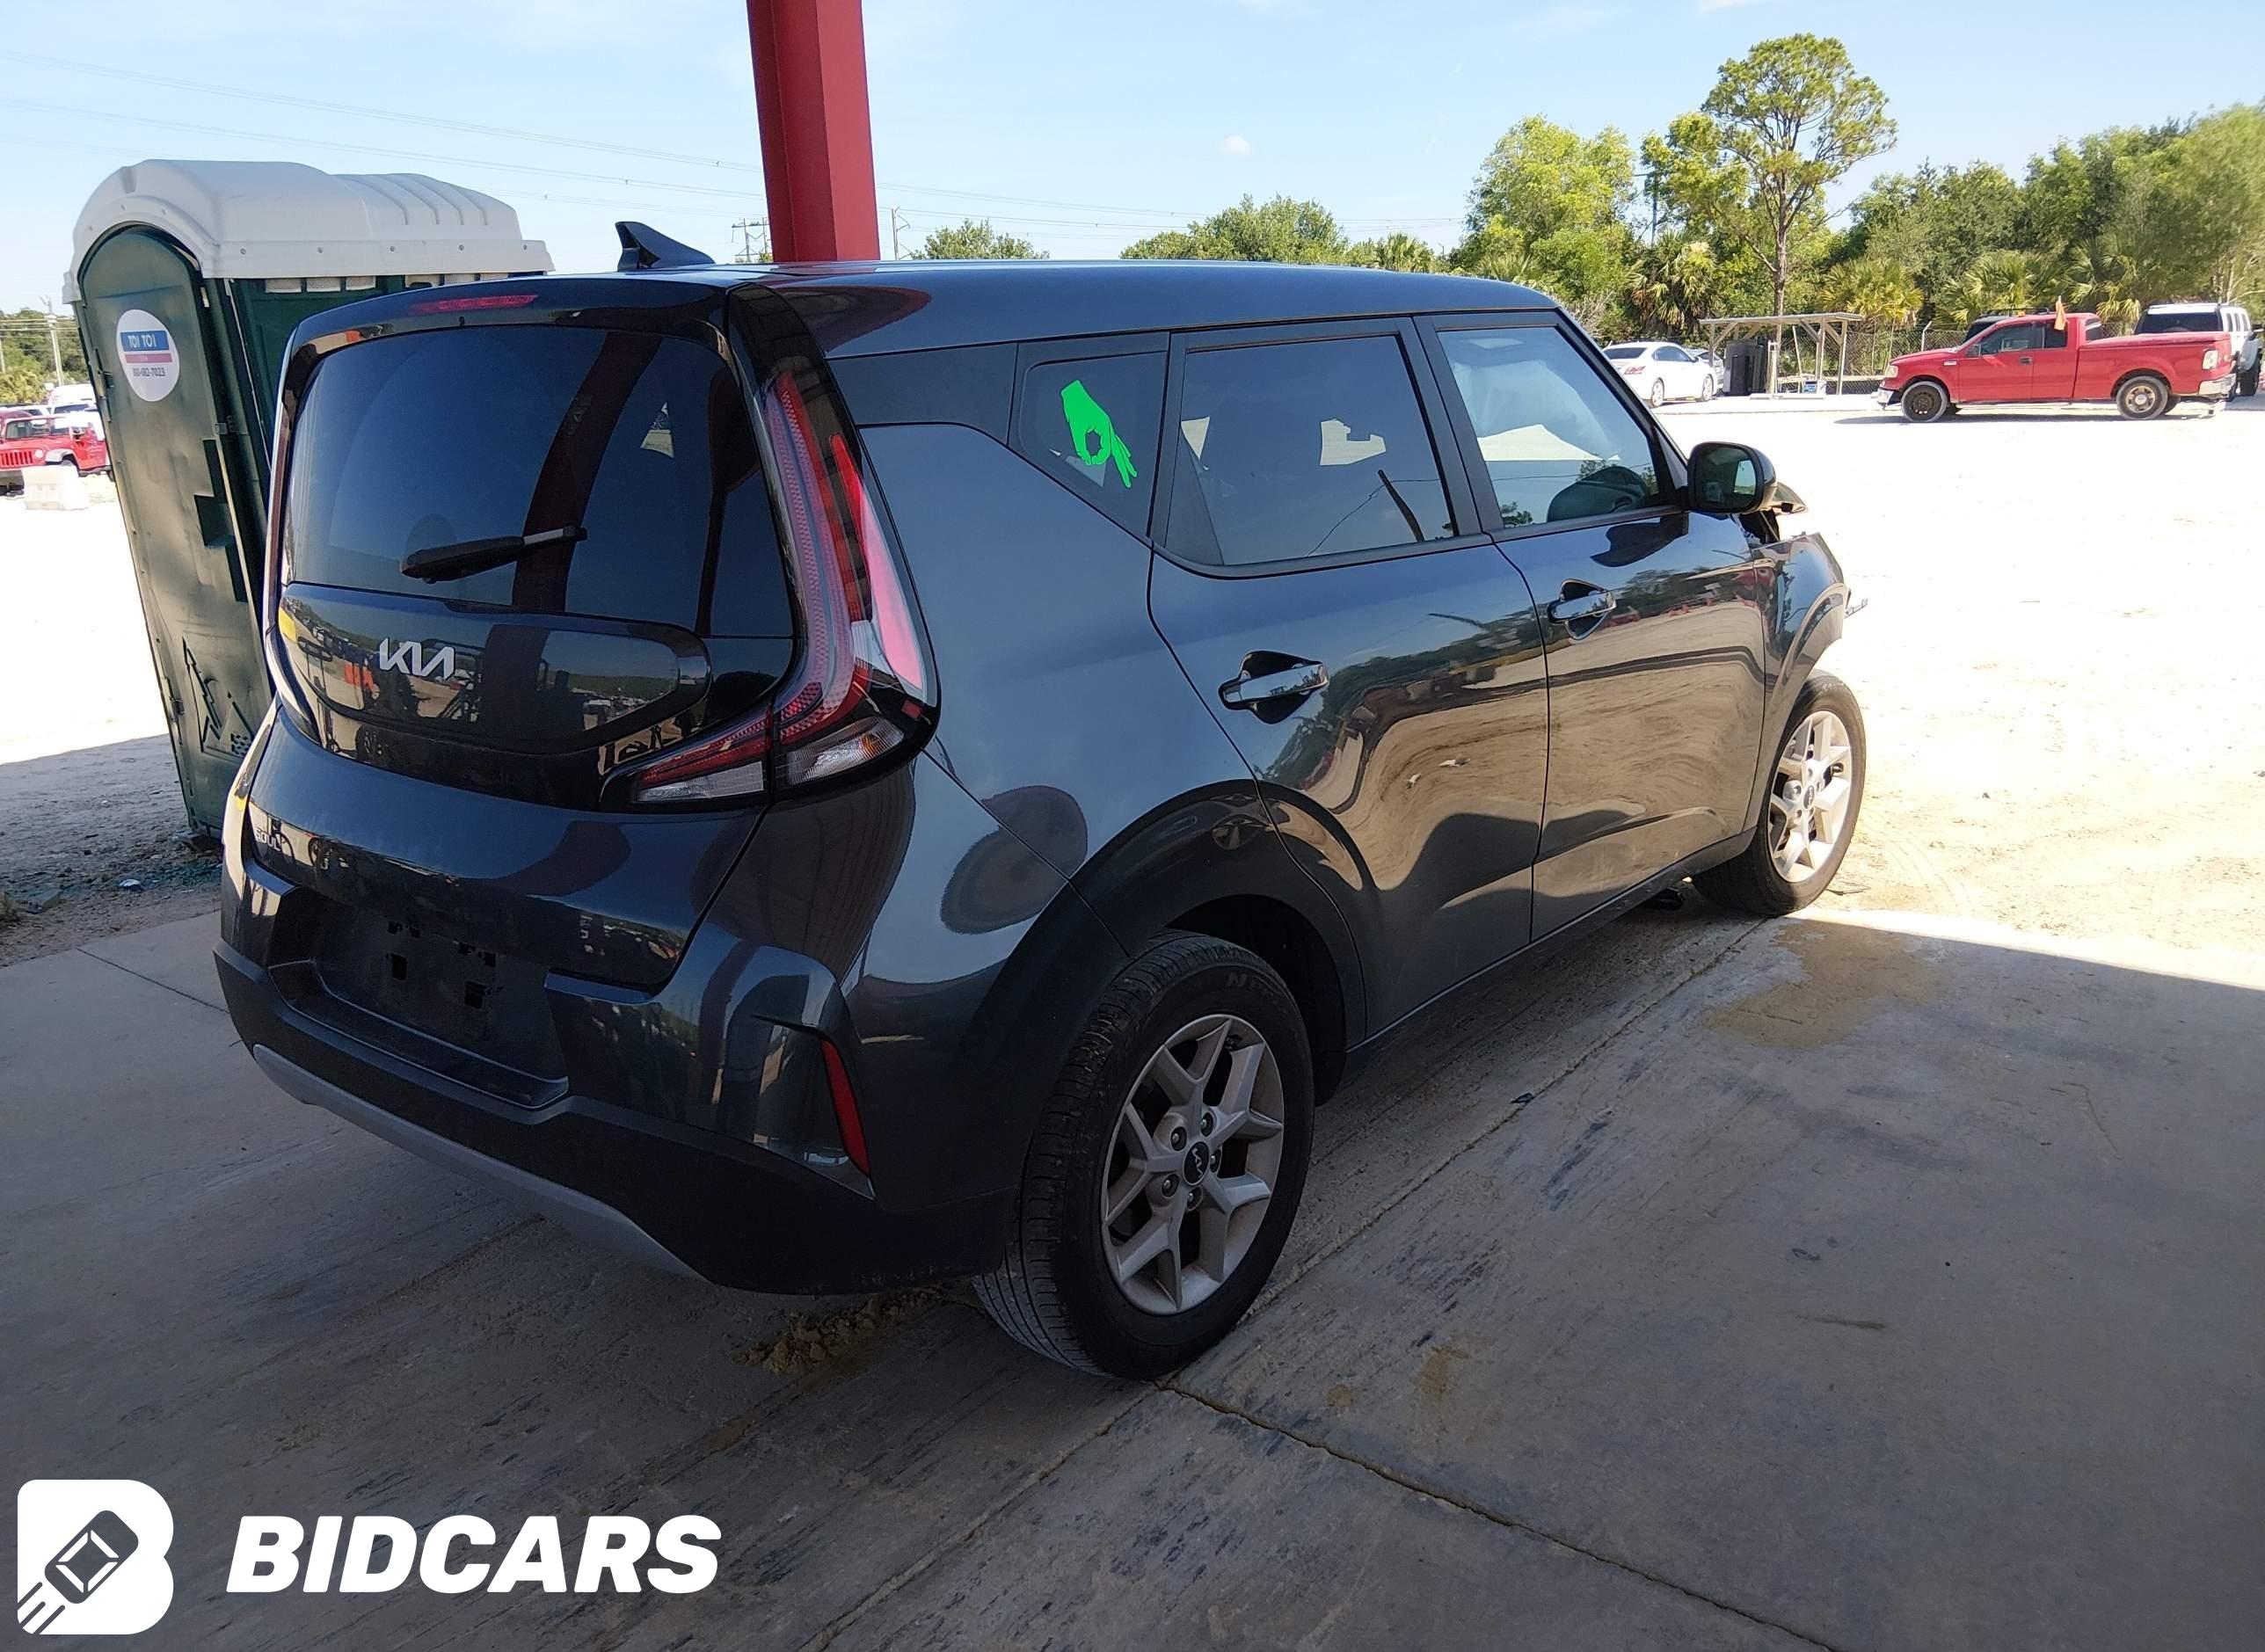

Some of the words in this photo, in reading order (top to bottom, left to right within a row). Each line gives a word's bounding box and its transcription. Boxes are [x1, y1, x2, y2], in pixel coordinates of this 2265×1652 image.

[127, 334, 141, 348] TOI
[142, 334, 157, 348] TOI
[379, 637, 455, 680] KIA
[254, 827, 281, 851] SOUL
